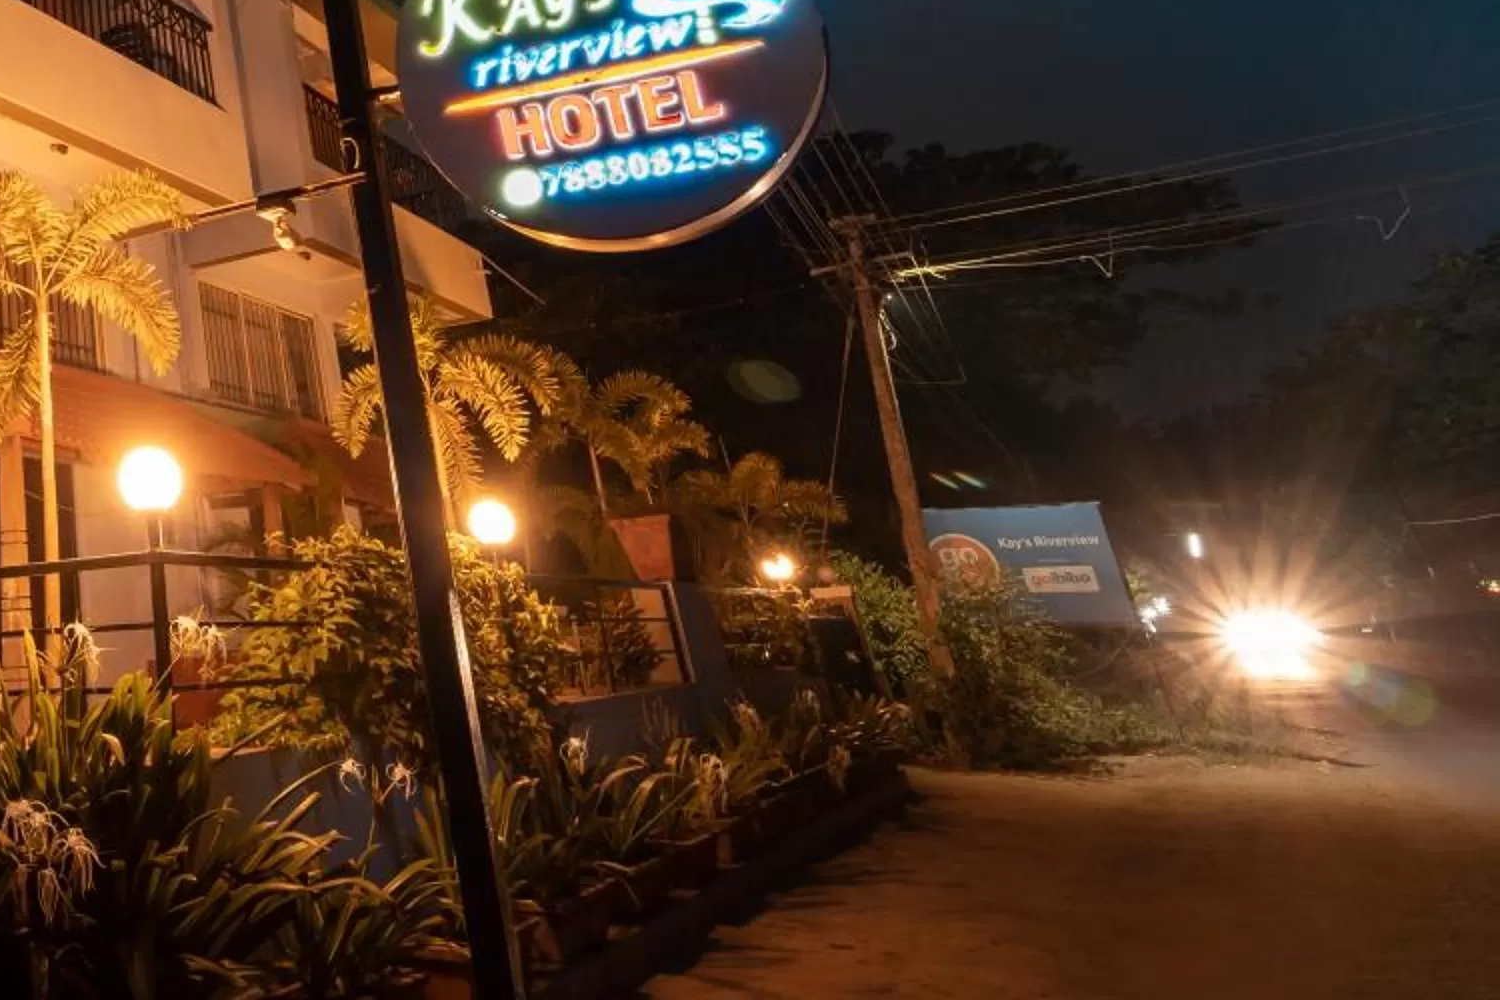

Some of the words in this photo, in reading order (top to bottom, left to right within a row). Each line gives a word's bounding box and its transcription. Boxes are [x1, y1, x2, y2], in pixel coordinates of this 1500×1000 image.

[472, 13, 696, 89] riverview
[496, 70, 727, 160] HOTEL
[997, 536, 1032, 551] Kay's
[1033, 534, 1100, 548] Riverview
